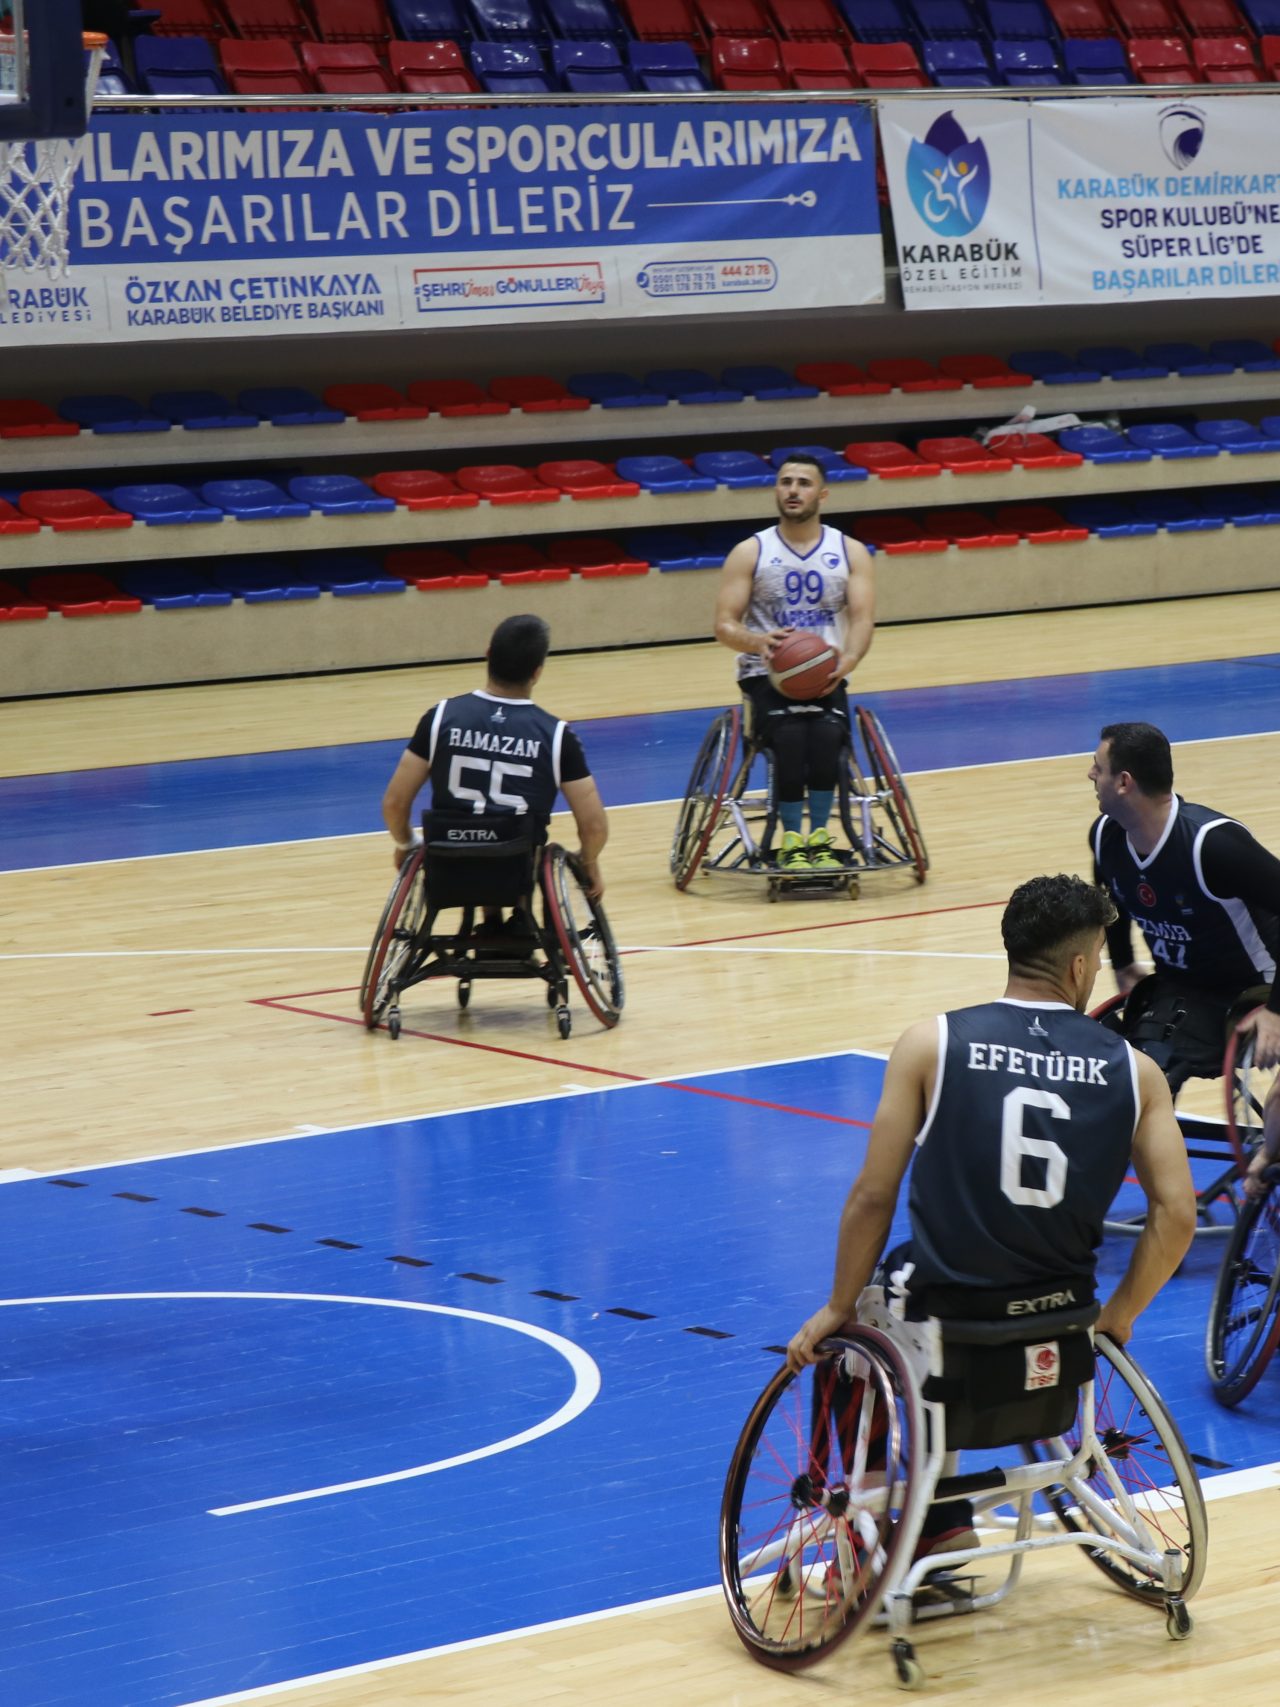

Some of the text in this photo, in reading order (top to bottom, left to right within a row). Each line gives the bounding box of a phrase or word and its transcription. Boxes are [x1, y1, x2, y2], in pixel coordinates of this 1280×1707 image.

[366, 127, 433, 176] VE
[446, 116, 862, 175] SPORCULARIMIZA
[1058, 173, 1161, 199] KARABÜK
[80, 174, 635, 254] BAŞARILAR DİLERİZ
[1101, 201, 1280, 229] SPOR KULUBÜ'NE
[902, 238, 1019, 264] KARABÜK
[1121, 232, 1264, 258] SÜPER LİG'DE
[720, 265, 742, 276] 444
[903, 264, 1022, 281] ÖZEL EĞİTİM
[1092, 266, 1214, 294] BAŞARILAR
[125, 275, 223, 305] ÖZKAN
[127, 305, 216, 327] KARABÜK
[308, 299, 385, 321] BAŞKANI
[785, 570, 824, 605] 99
[449, 728, 541, 759] RAMAZAN
[448, 754, 533, 815] 55
[447, 829, 498, 841] EXTRA
[967, 1042, 1108, 1086] EFETÜRK
[1000, 1086, 1071, 1209] 6
[1007, 1289, 1076, 1315] EXTRA
